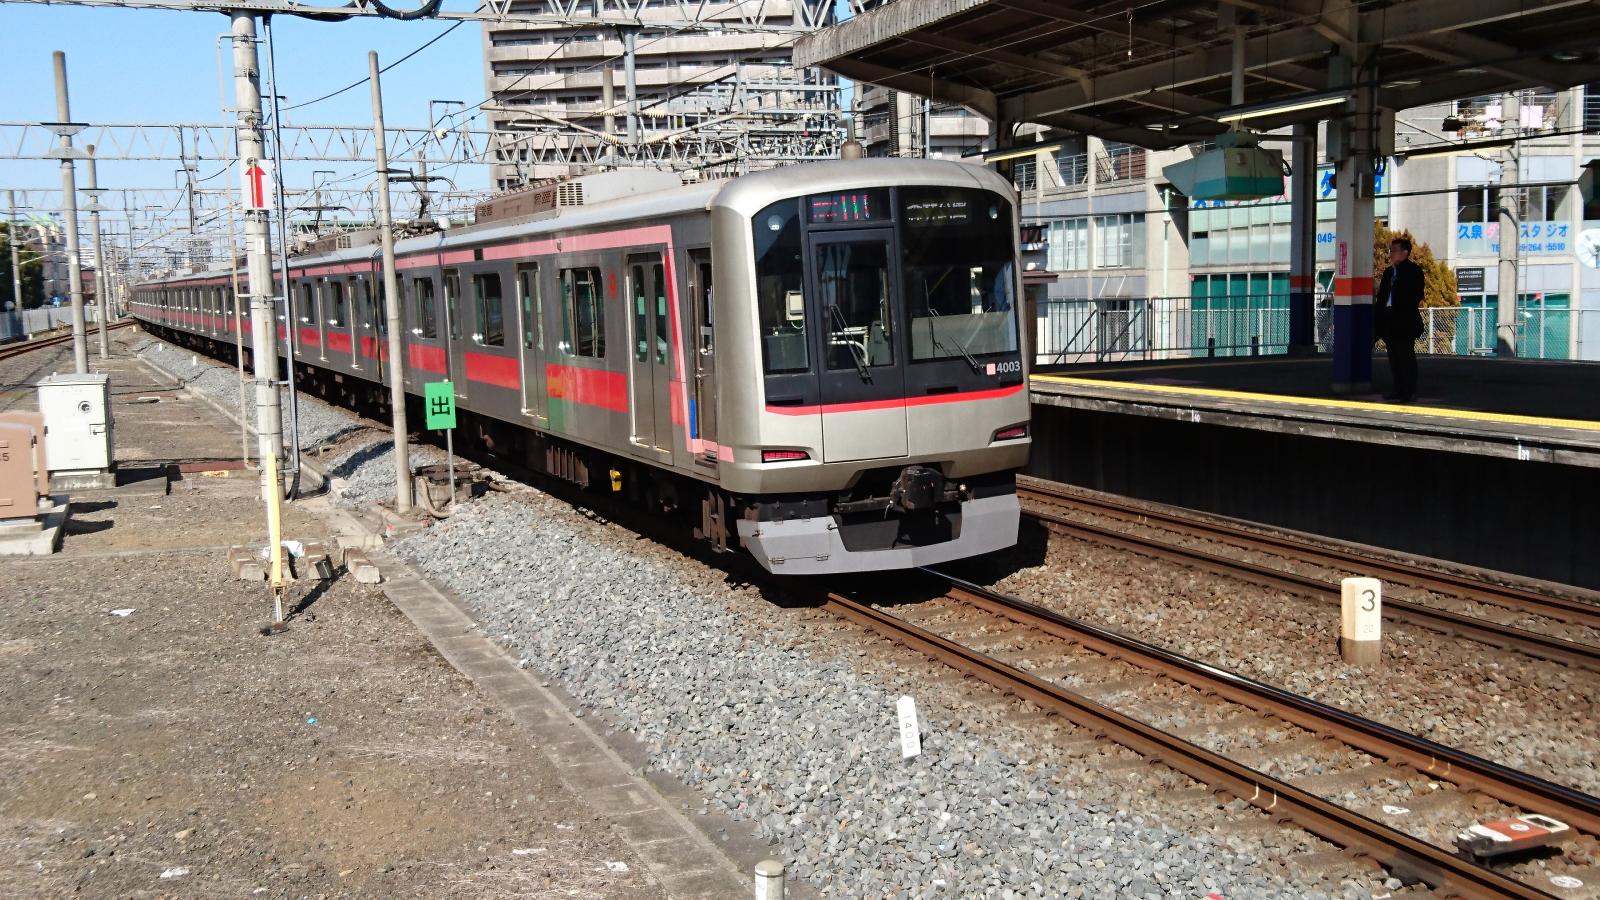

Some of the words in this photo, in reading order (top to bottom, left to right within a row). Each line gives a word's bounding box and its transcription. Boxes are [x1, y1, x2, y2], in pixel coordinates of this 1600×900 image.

[997, 361, 1021, 373] 4003
[432, 395, 450, 416] 出
[1361, 589, 1376, 612] 3
[903, 713, 916, 749] 1400
